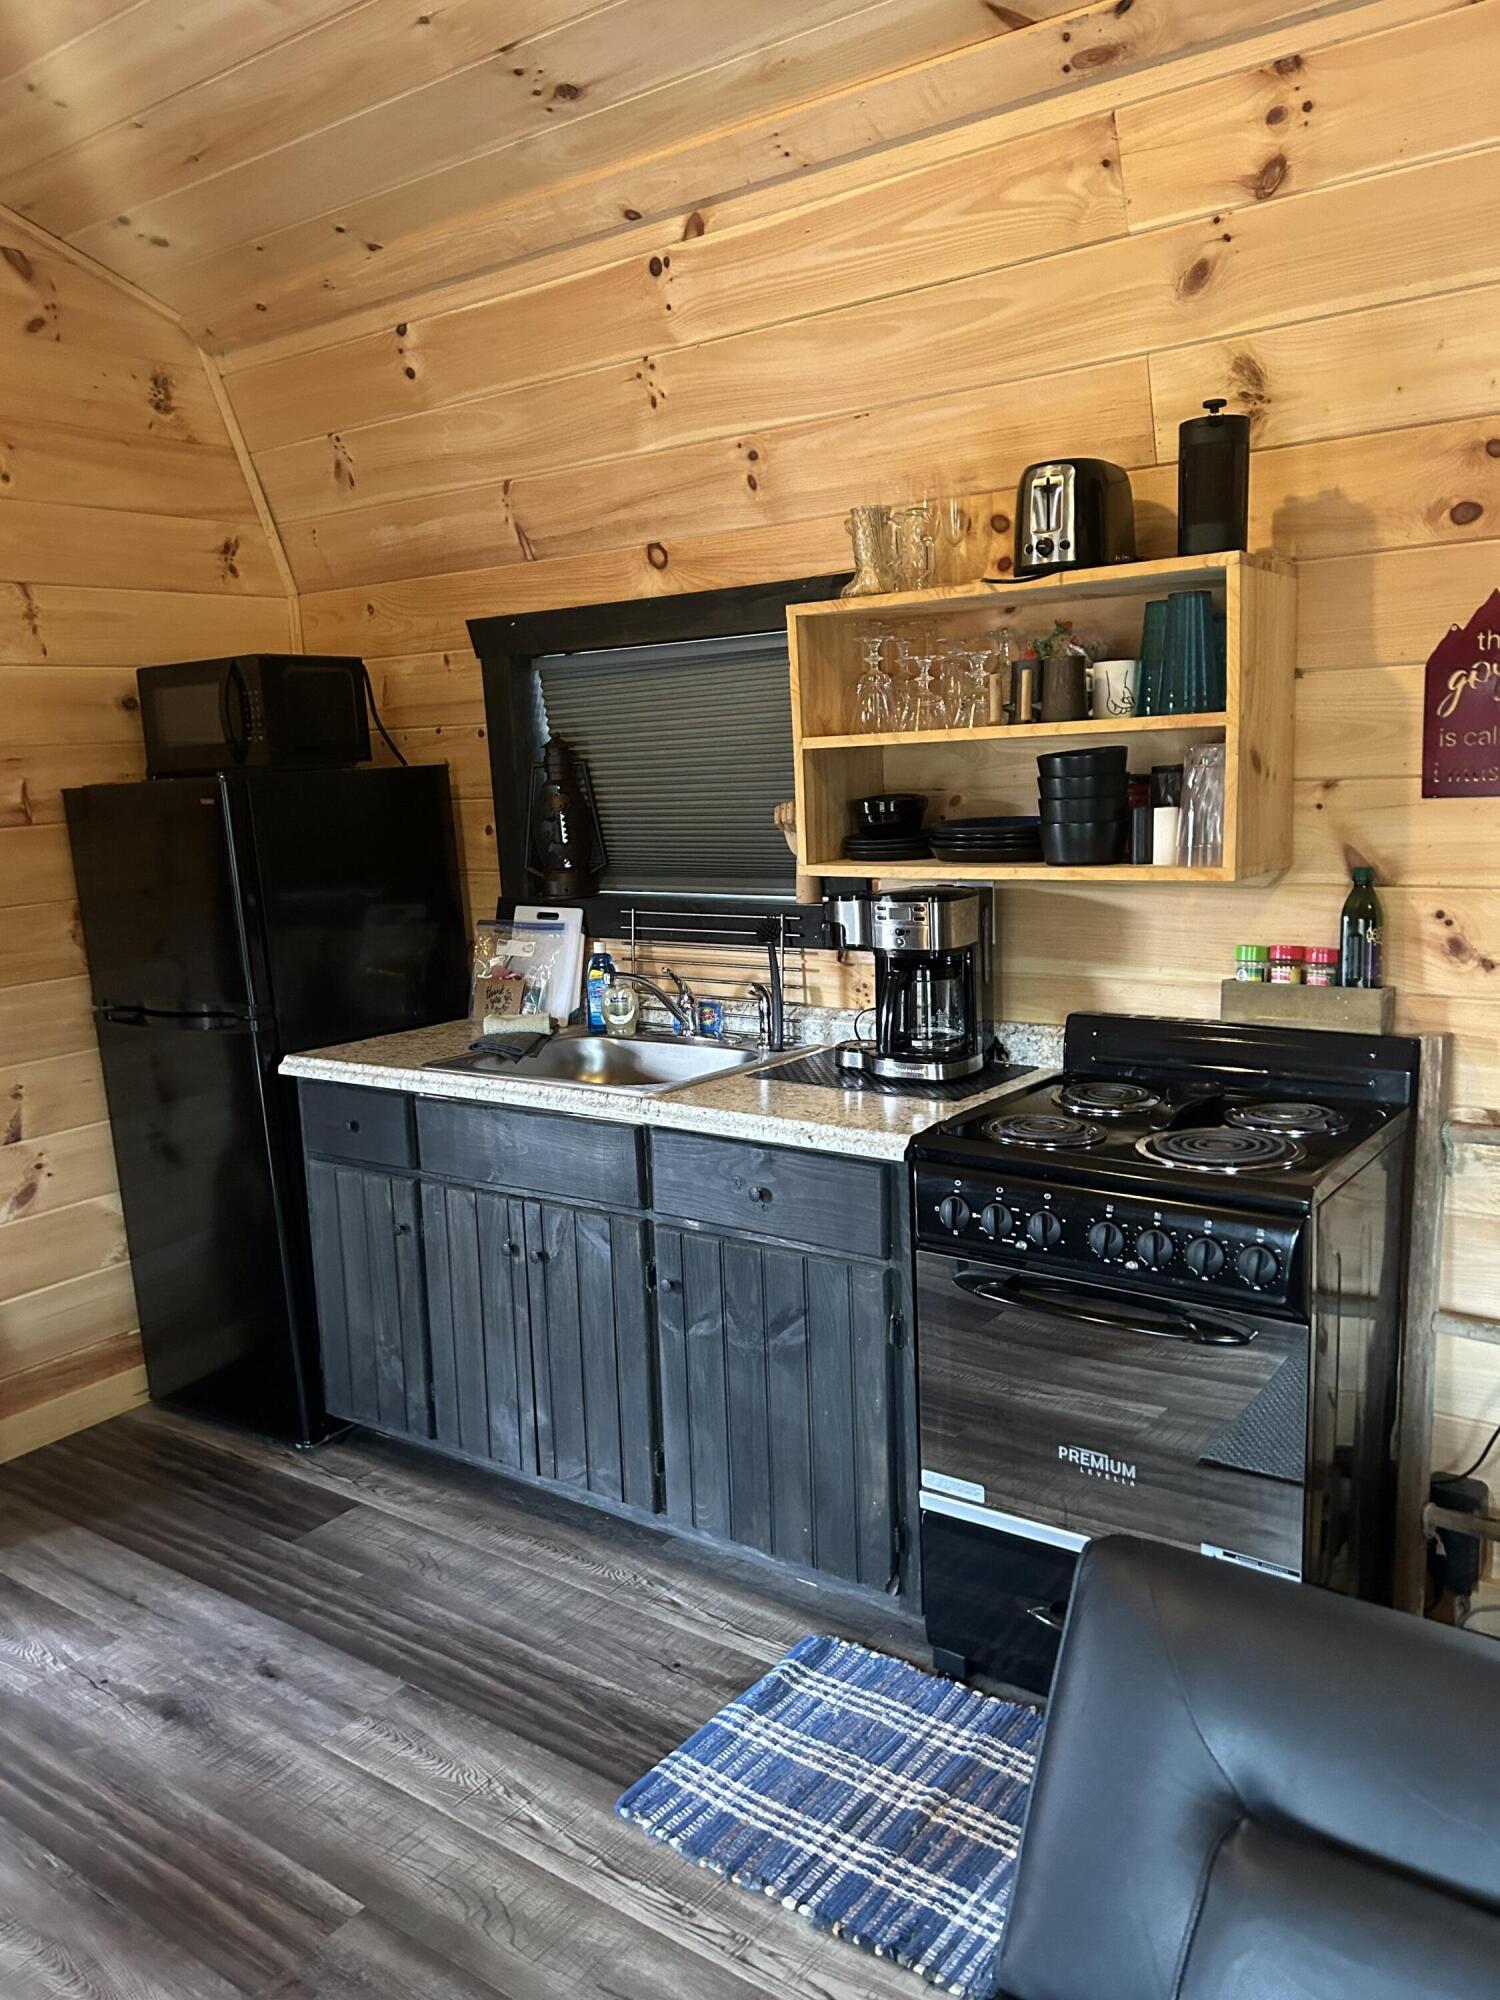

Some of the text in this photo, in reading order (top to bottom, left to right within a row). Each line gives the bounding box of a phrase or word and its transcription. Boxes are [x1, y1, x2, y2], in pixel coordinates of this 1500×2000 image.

[1439, 727, 1457, 748] is
[1058, 1445, 1136, 1479] PREMIUM
[1080, 1466, 1136, 1488] LEVELLA
